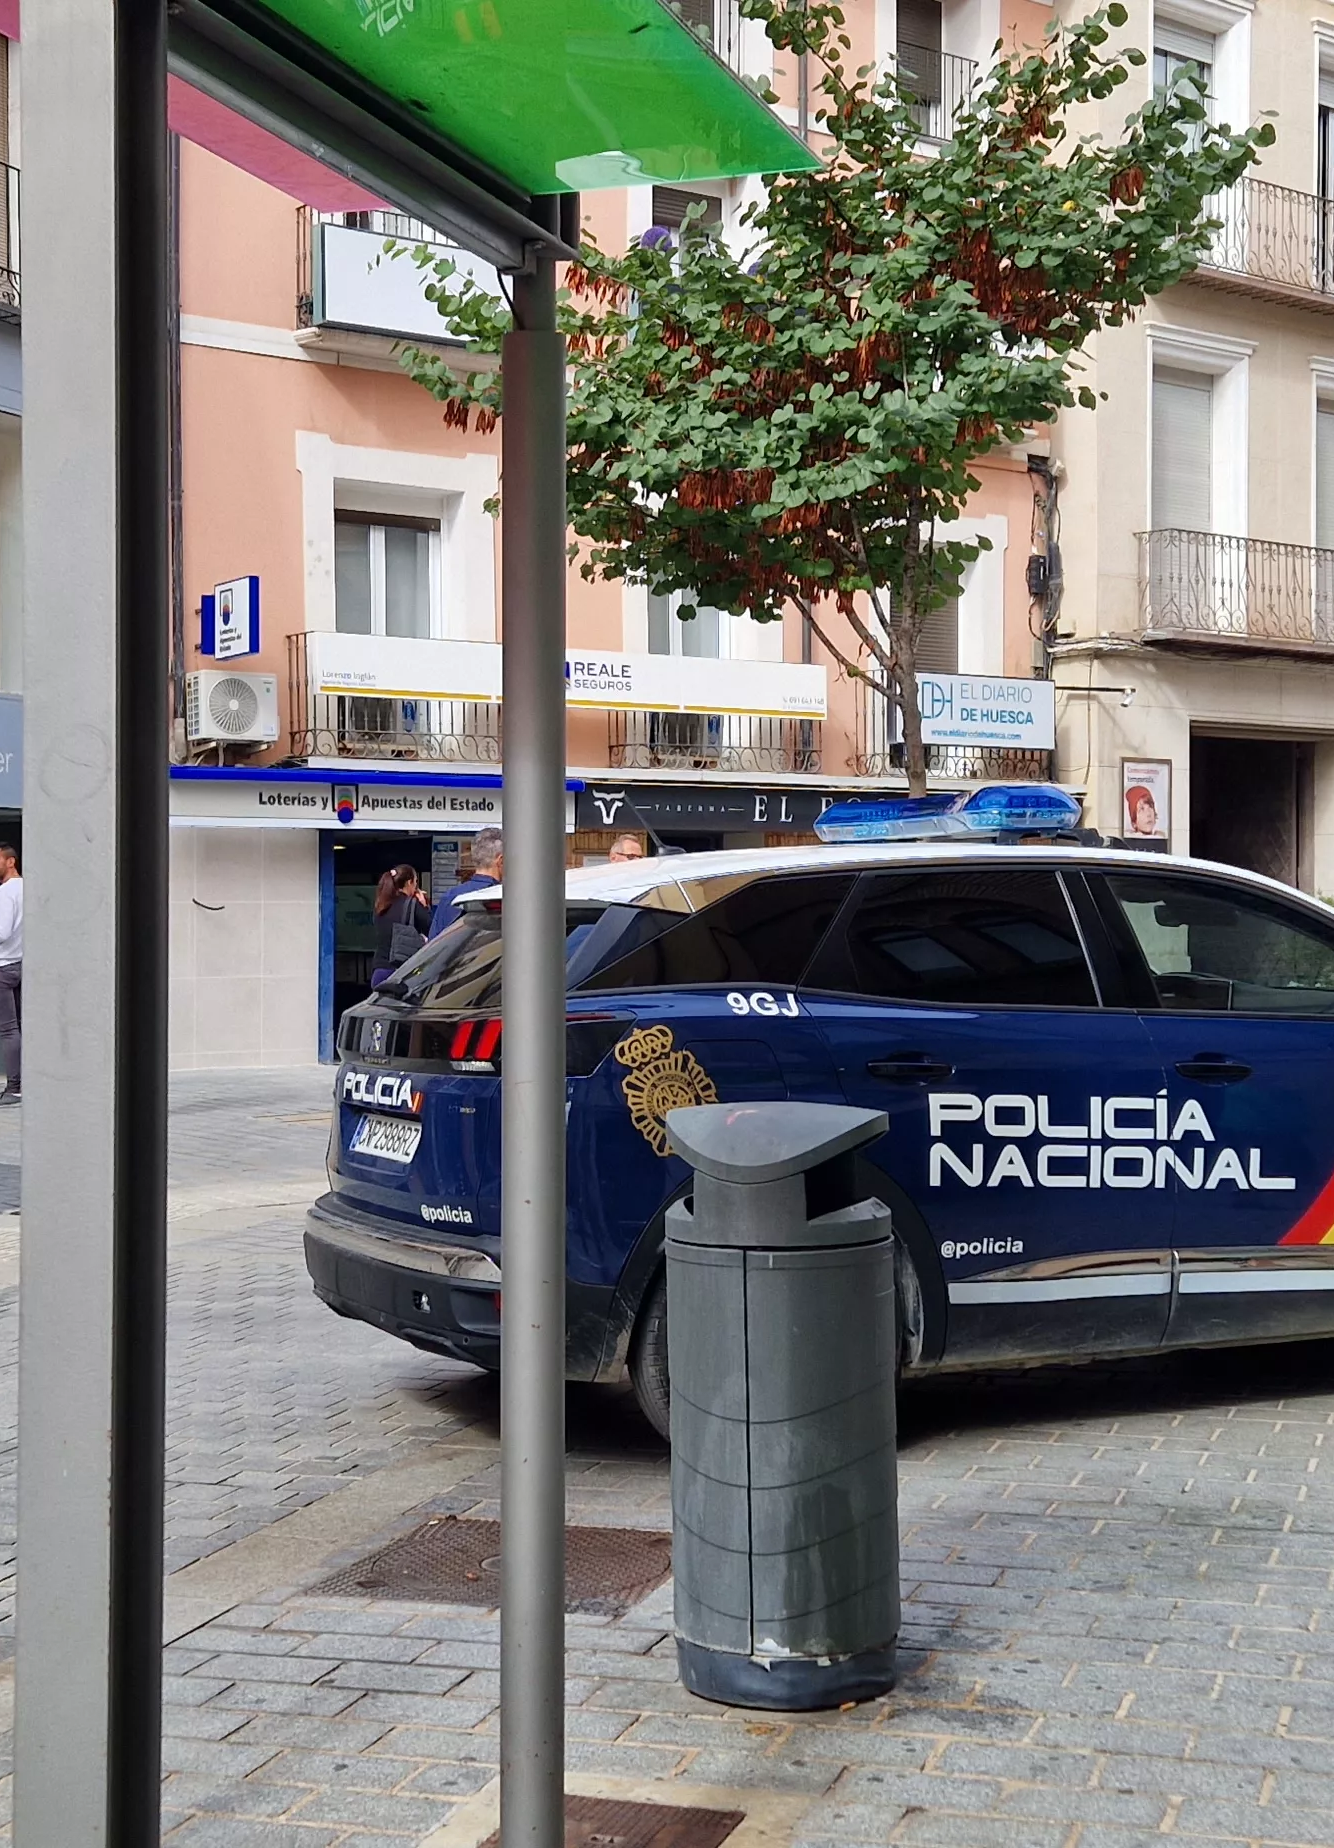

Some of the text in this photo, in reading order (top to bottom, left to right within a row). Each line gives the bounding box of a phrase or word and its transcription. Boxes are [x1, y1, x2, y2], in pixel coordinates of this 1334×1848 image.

[574, 661, 632, 678] REALE
[574, 679, 632, 692] SEGUROS
[960, 682, 979, 700] EL
[982, 684, 1033, 703] DIARIO
[960, 707, 1034, 725] DE HUESCA
[258, 792, 495, 812] Loterías y Apuestas del Estado
[727, 991, 800, 1017] 9GJ
[928, 1088, 1216, 1142] POLICÍA
[928, 1142, 1296, 1190] NACIONAL
[940, 1236, 1024, 1260] @policia
